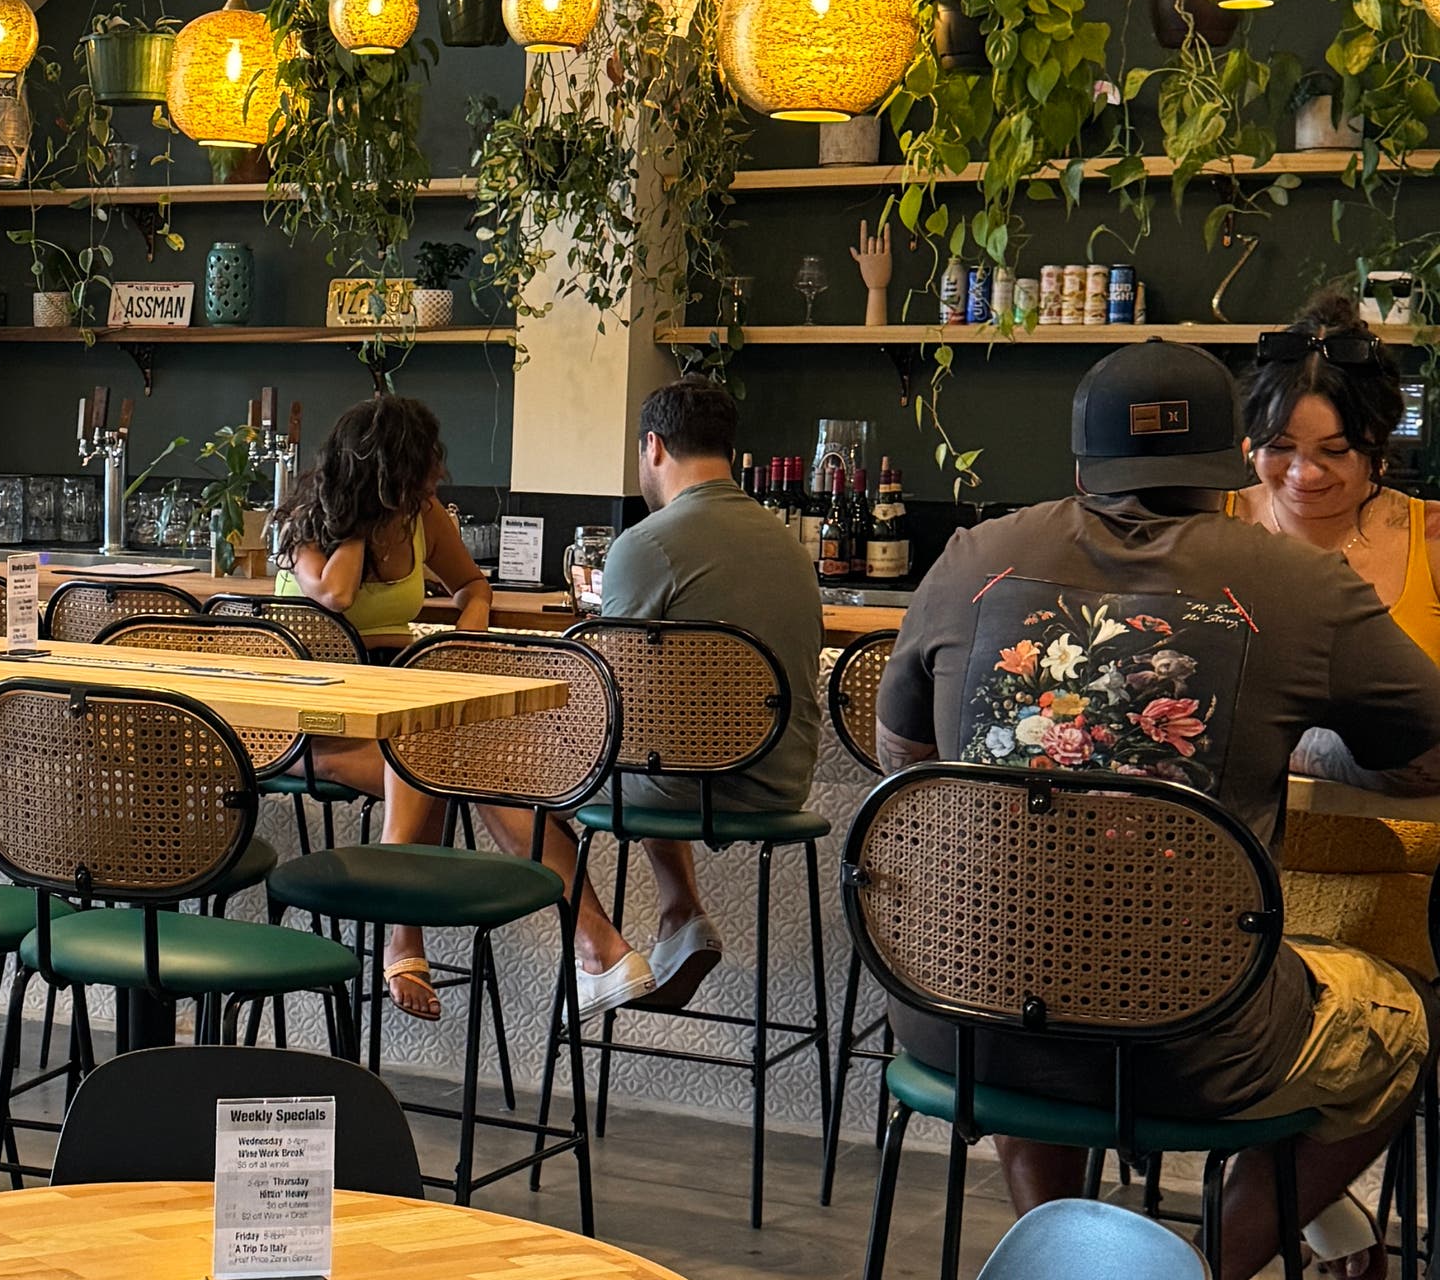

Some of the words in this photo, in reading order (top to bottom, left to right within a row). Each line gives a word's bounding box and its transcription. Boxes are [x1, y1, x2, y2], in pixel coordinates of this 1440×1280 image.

[124, 296, 186, 319] ASSMAN
[230, 1109, 273, 1124] Weekly
[276, 1108, 326, 1124] Specials
[238, 1137, 283, 1147] Wednesday
[281, 1148, 305, 1158] Break
[273, 1177, 309, 1187] Thursday
[285, 1190, 309, 1200] Heavy
[235, 1232, 260, 1242] Friday
[234, 1244, 241, 1254] A
[242, 1244, 258, 1254] Trip
[259, 1243, 269, 1253] To
[269, 1243, 288, 1254] Italy
